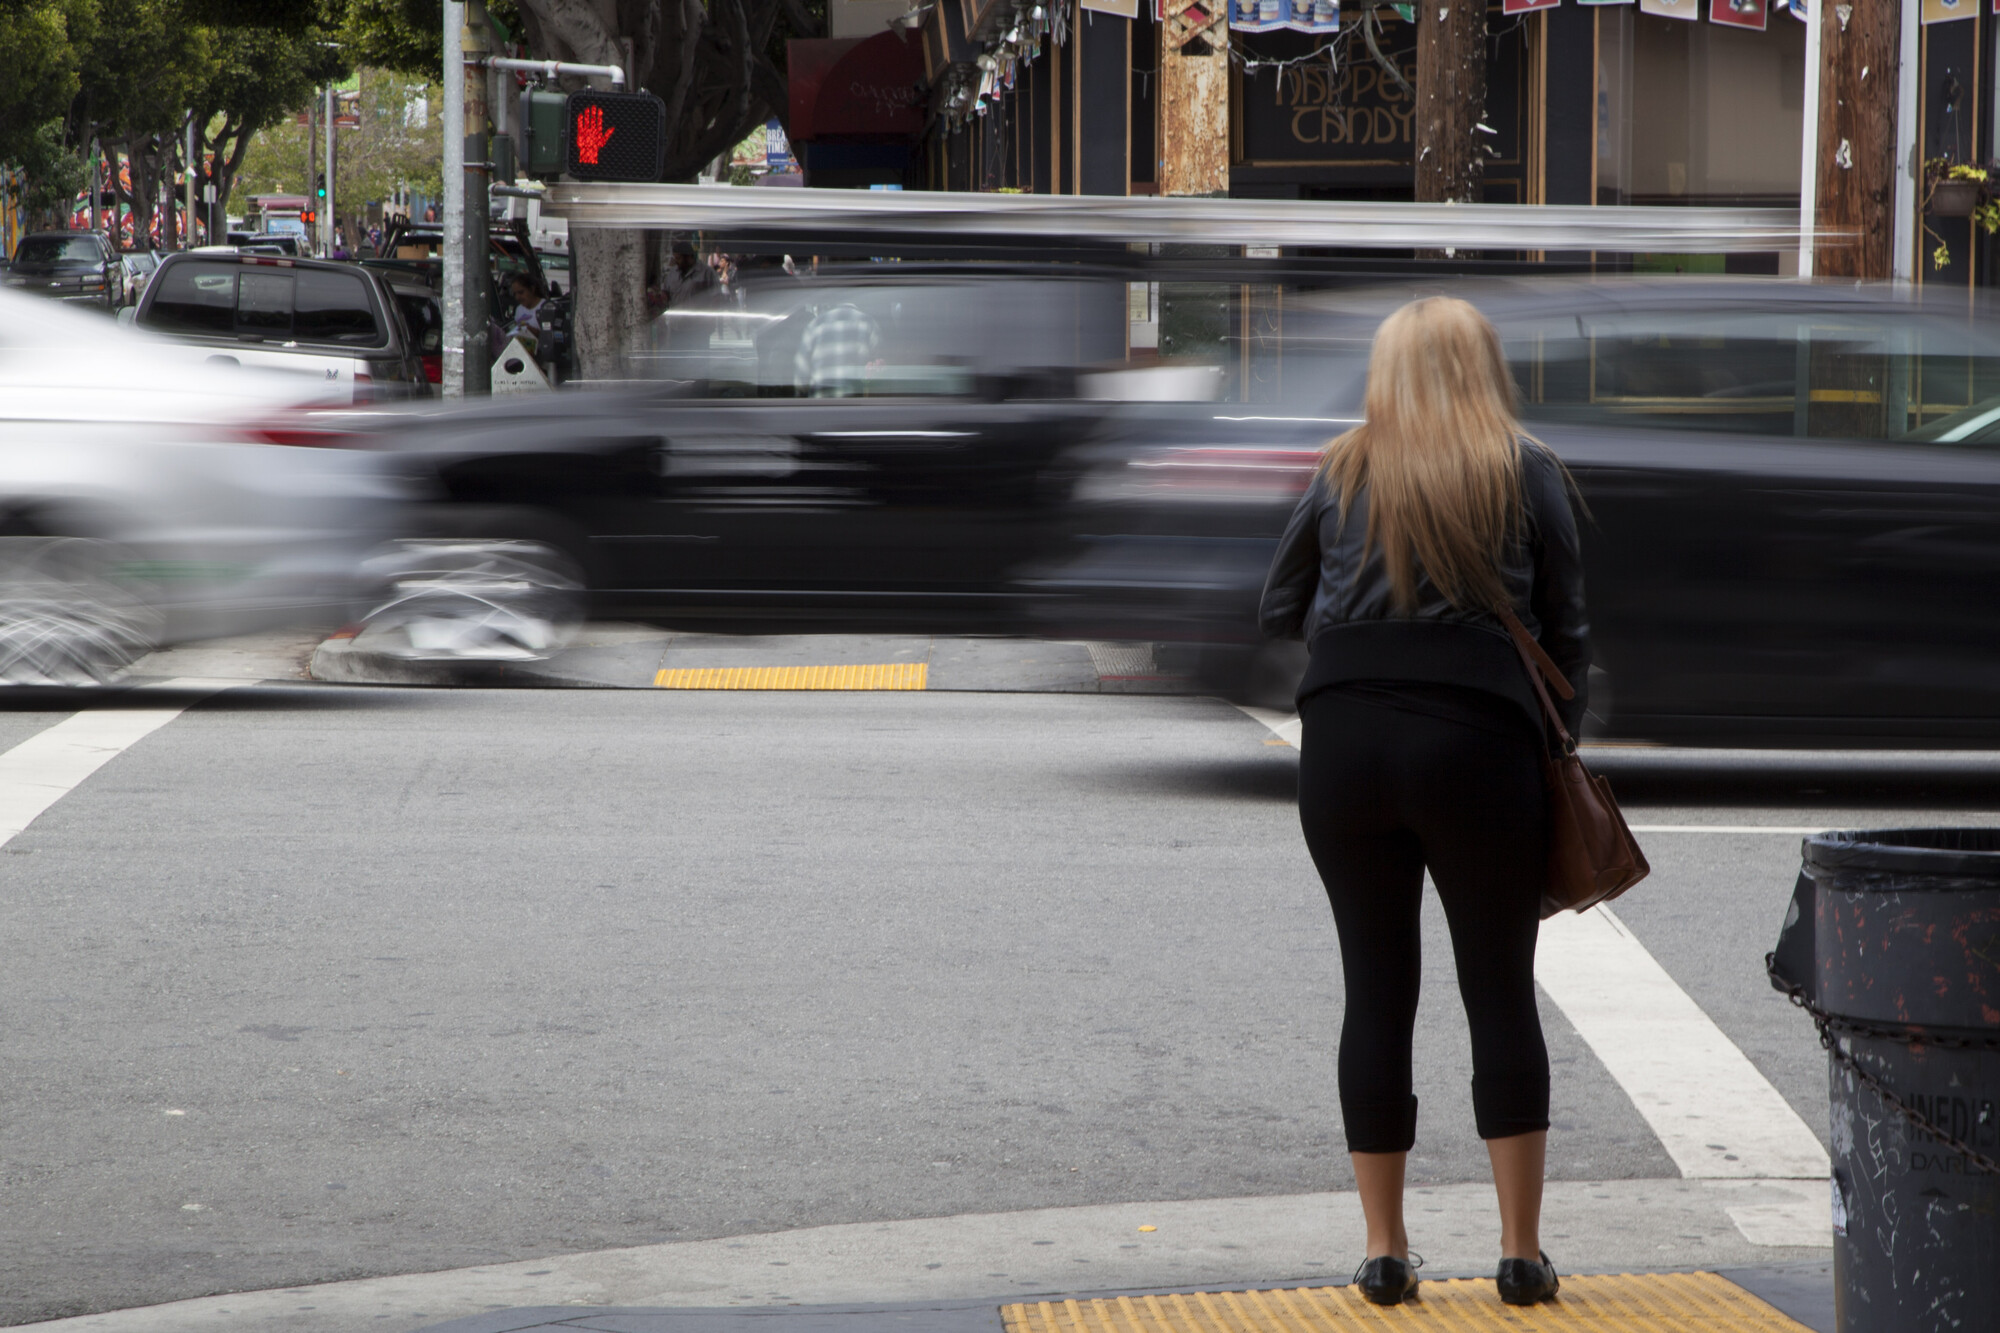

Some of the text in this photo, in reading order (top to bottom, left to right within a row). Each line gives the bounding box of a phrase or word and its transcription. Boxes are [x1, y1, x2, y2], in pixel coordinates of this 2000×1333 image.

[766, 128, 787, 142] BREA
[767, 141, 786, 154] TIME
[1911, 1151, 1996, 1177] DARL
